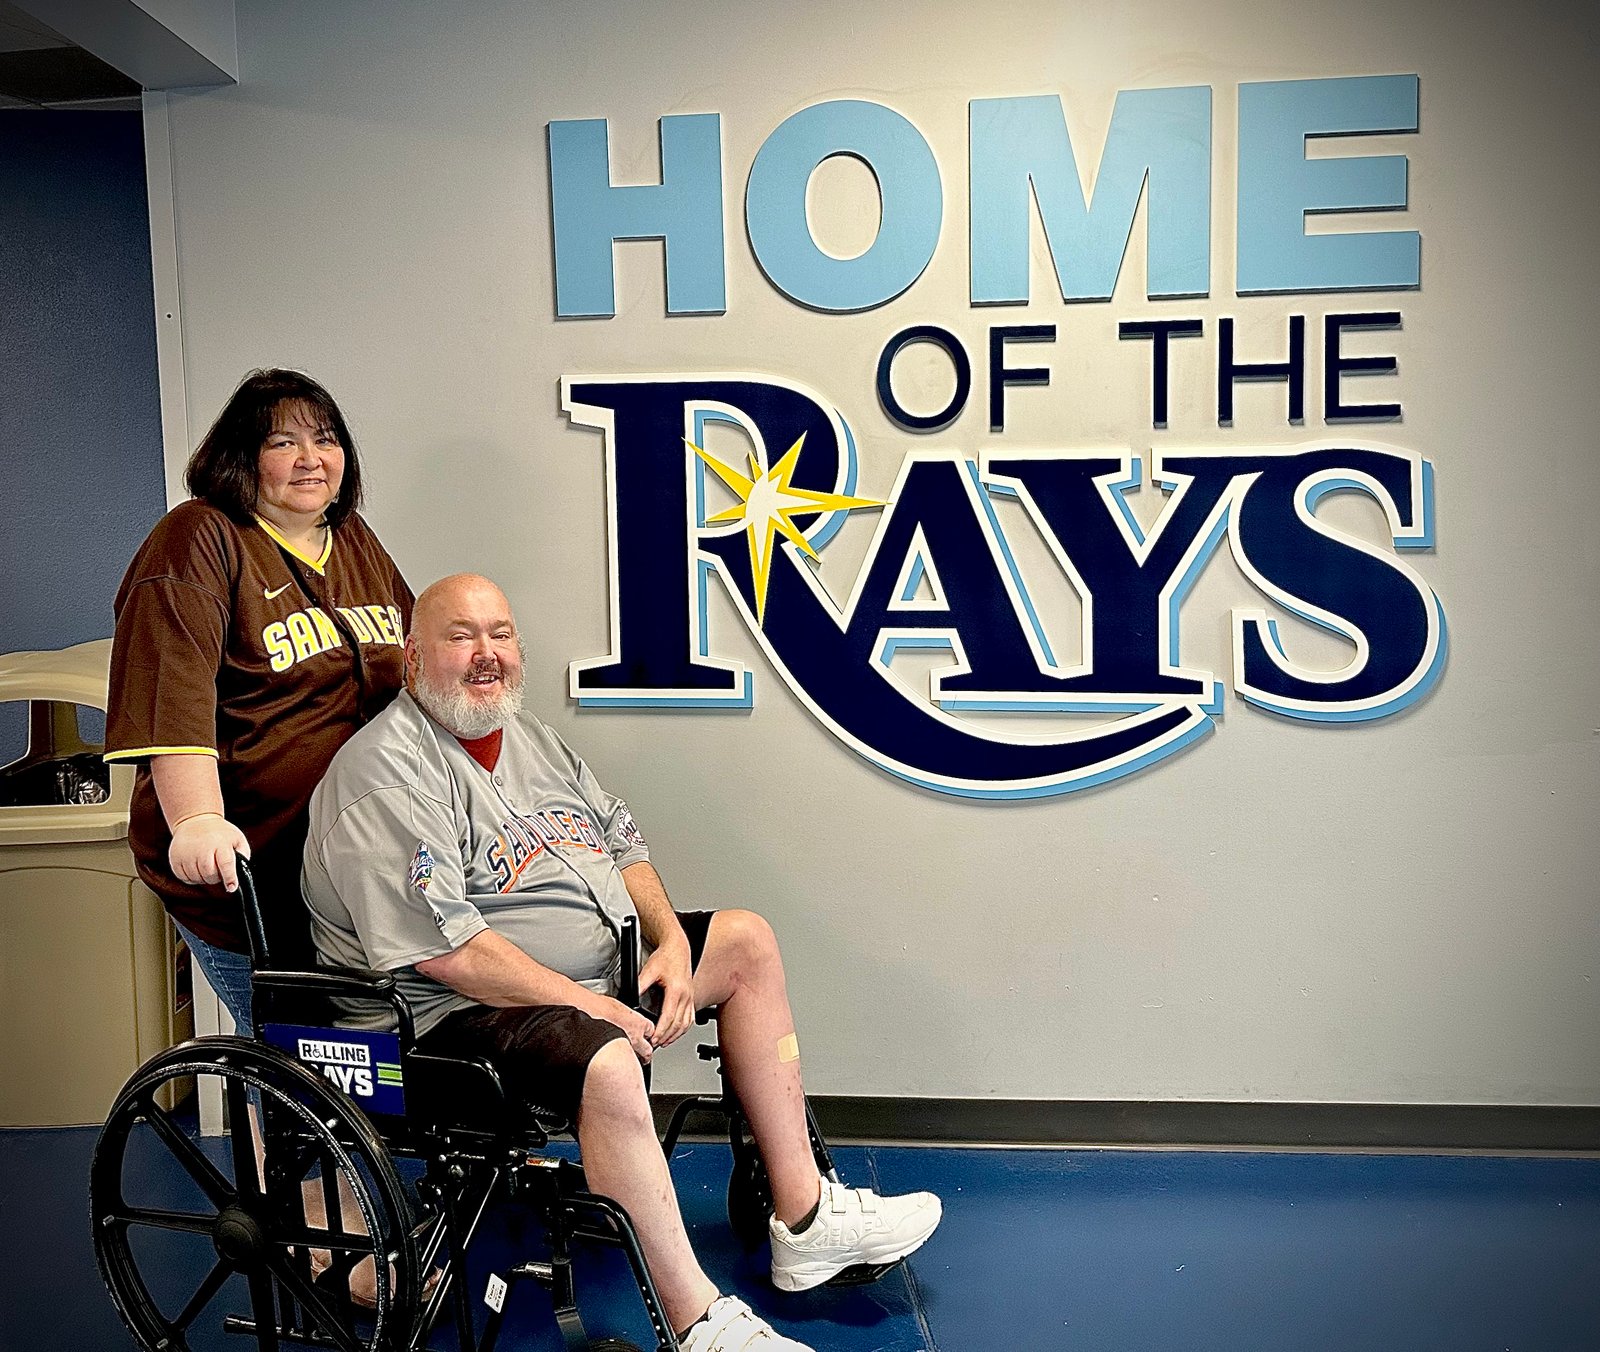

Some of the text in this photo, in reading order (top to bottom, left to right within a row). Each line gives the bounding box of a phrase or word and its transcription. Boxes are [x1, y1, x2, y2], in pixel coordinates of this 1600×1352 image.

[547, 74, 1421, 318] HOME
[876, 312, 1403, 433] OF THE
[560, 372, 1449, 800] RAYS
[262, 604, 405, 673] SAN DIEG
[301, 1043, 367, 1062] ROLLING
[310, 1063, 374, 1096] AYS
